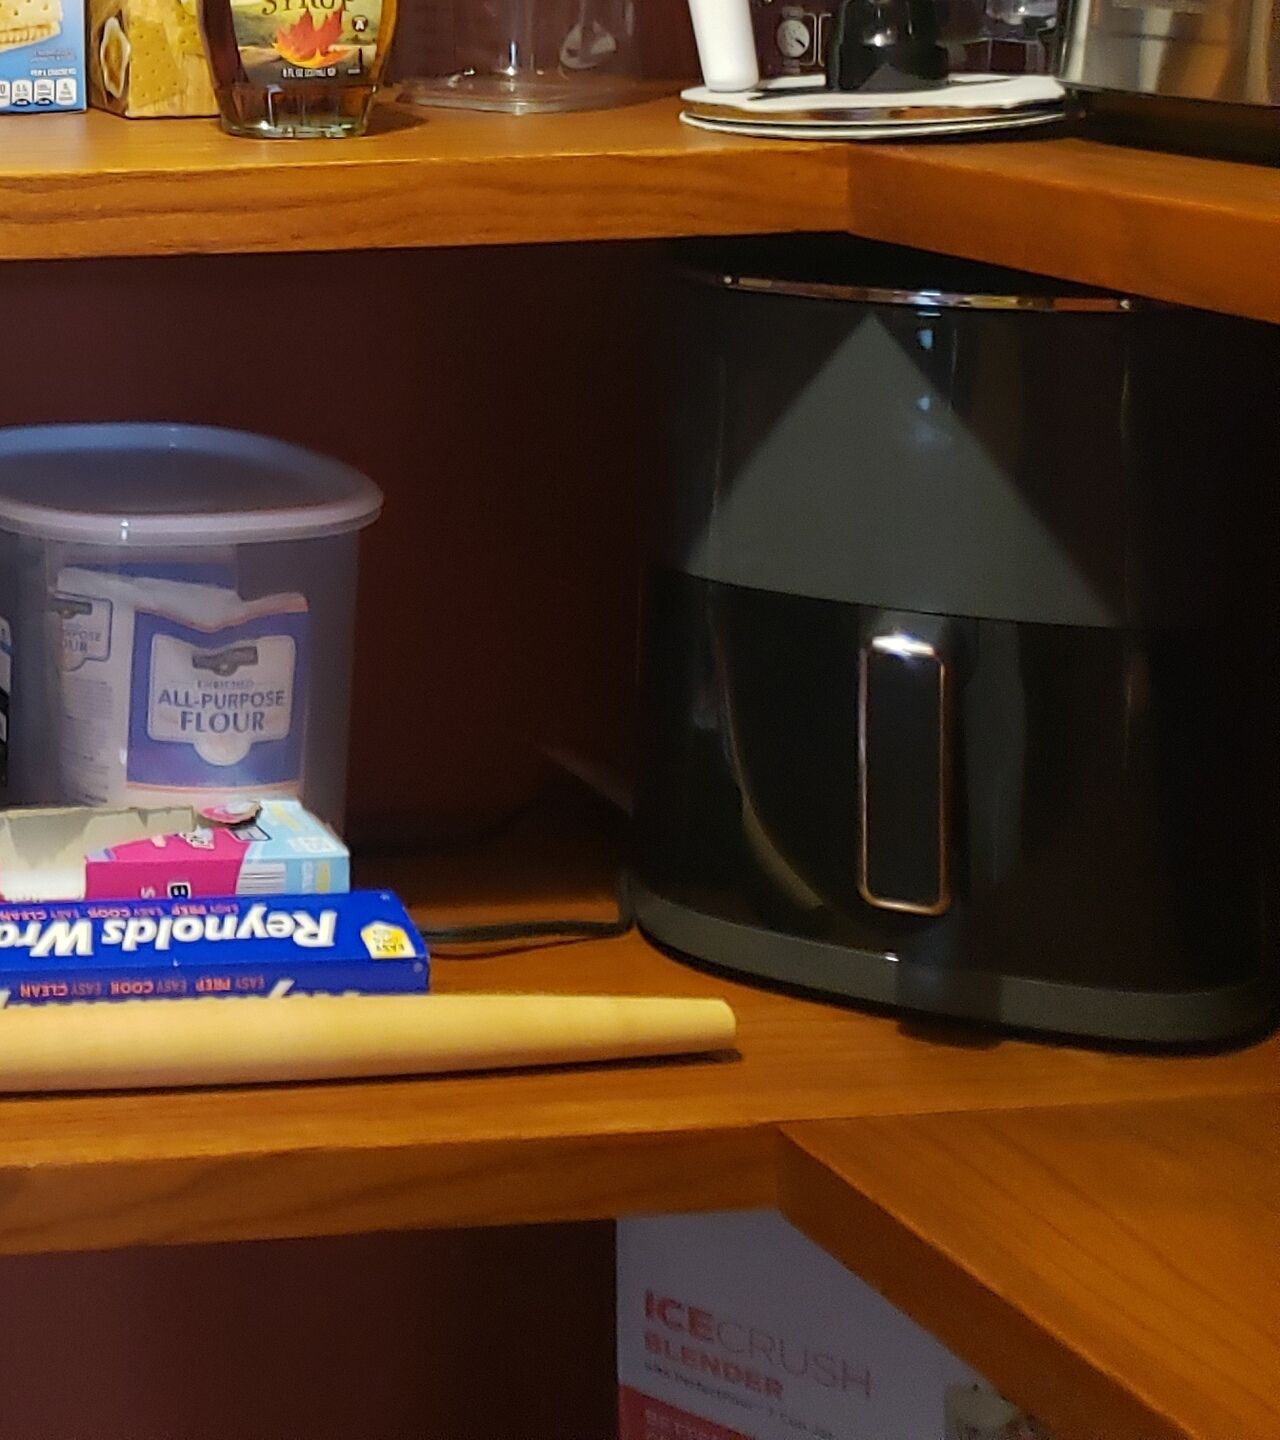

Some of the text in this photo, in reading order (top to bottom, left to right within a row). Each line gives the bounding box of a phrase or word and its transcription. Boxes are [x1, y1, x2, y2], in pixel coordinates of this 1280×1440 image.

[157, 690, 286, 708] ALL-PURPOSE
[179, 710, 266, 733] FLOUR
[101, 905, 338, 953] Reynolds
[19, 981, 68, 998] CLEAN
[110, 979, 154, 994] COOK
[196, 976, 231, 992] PREP
